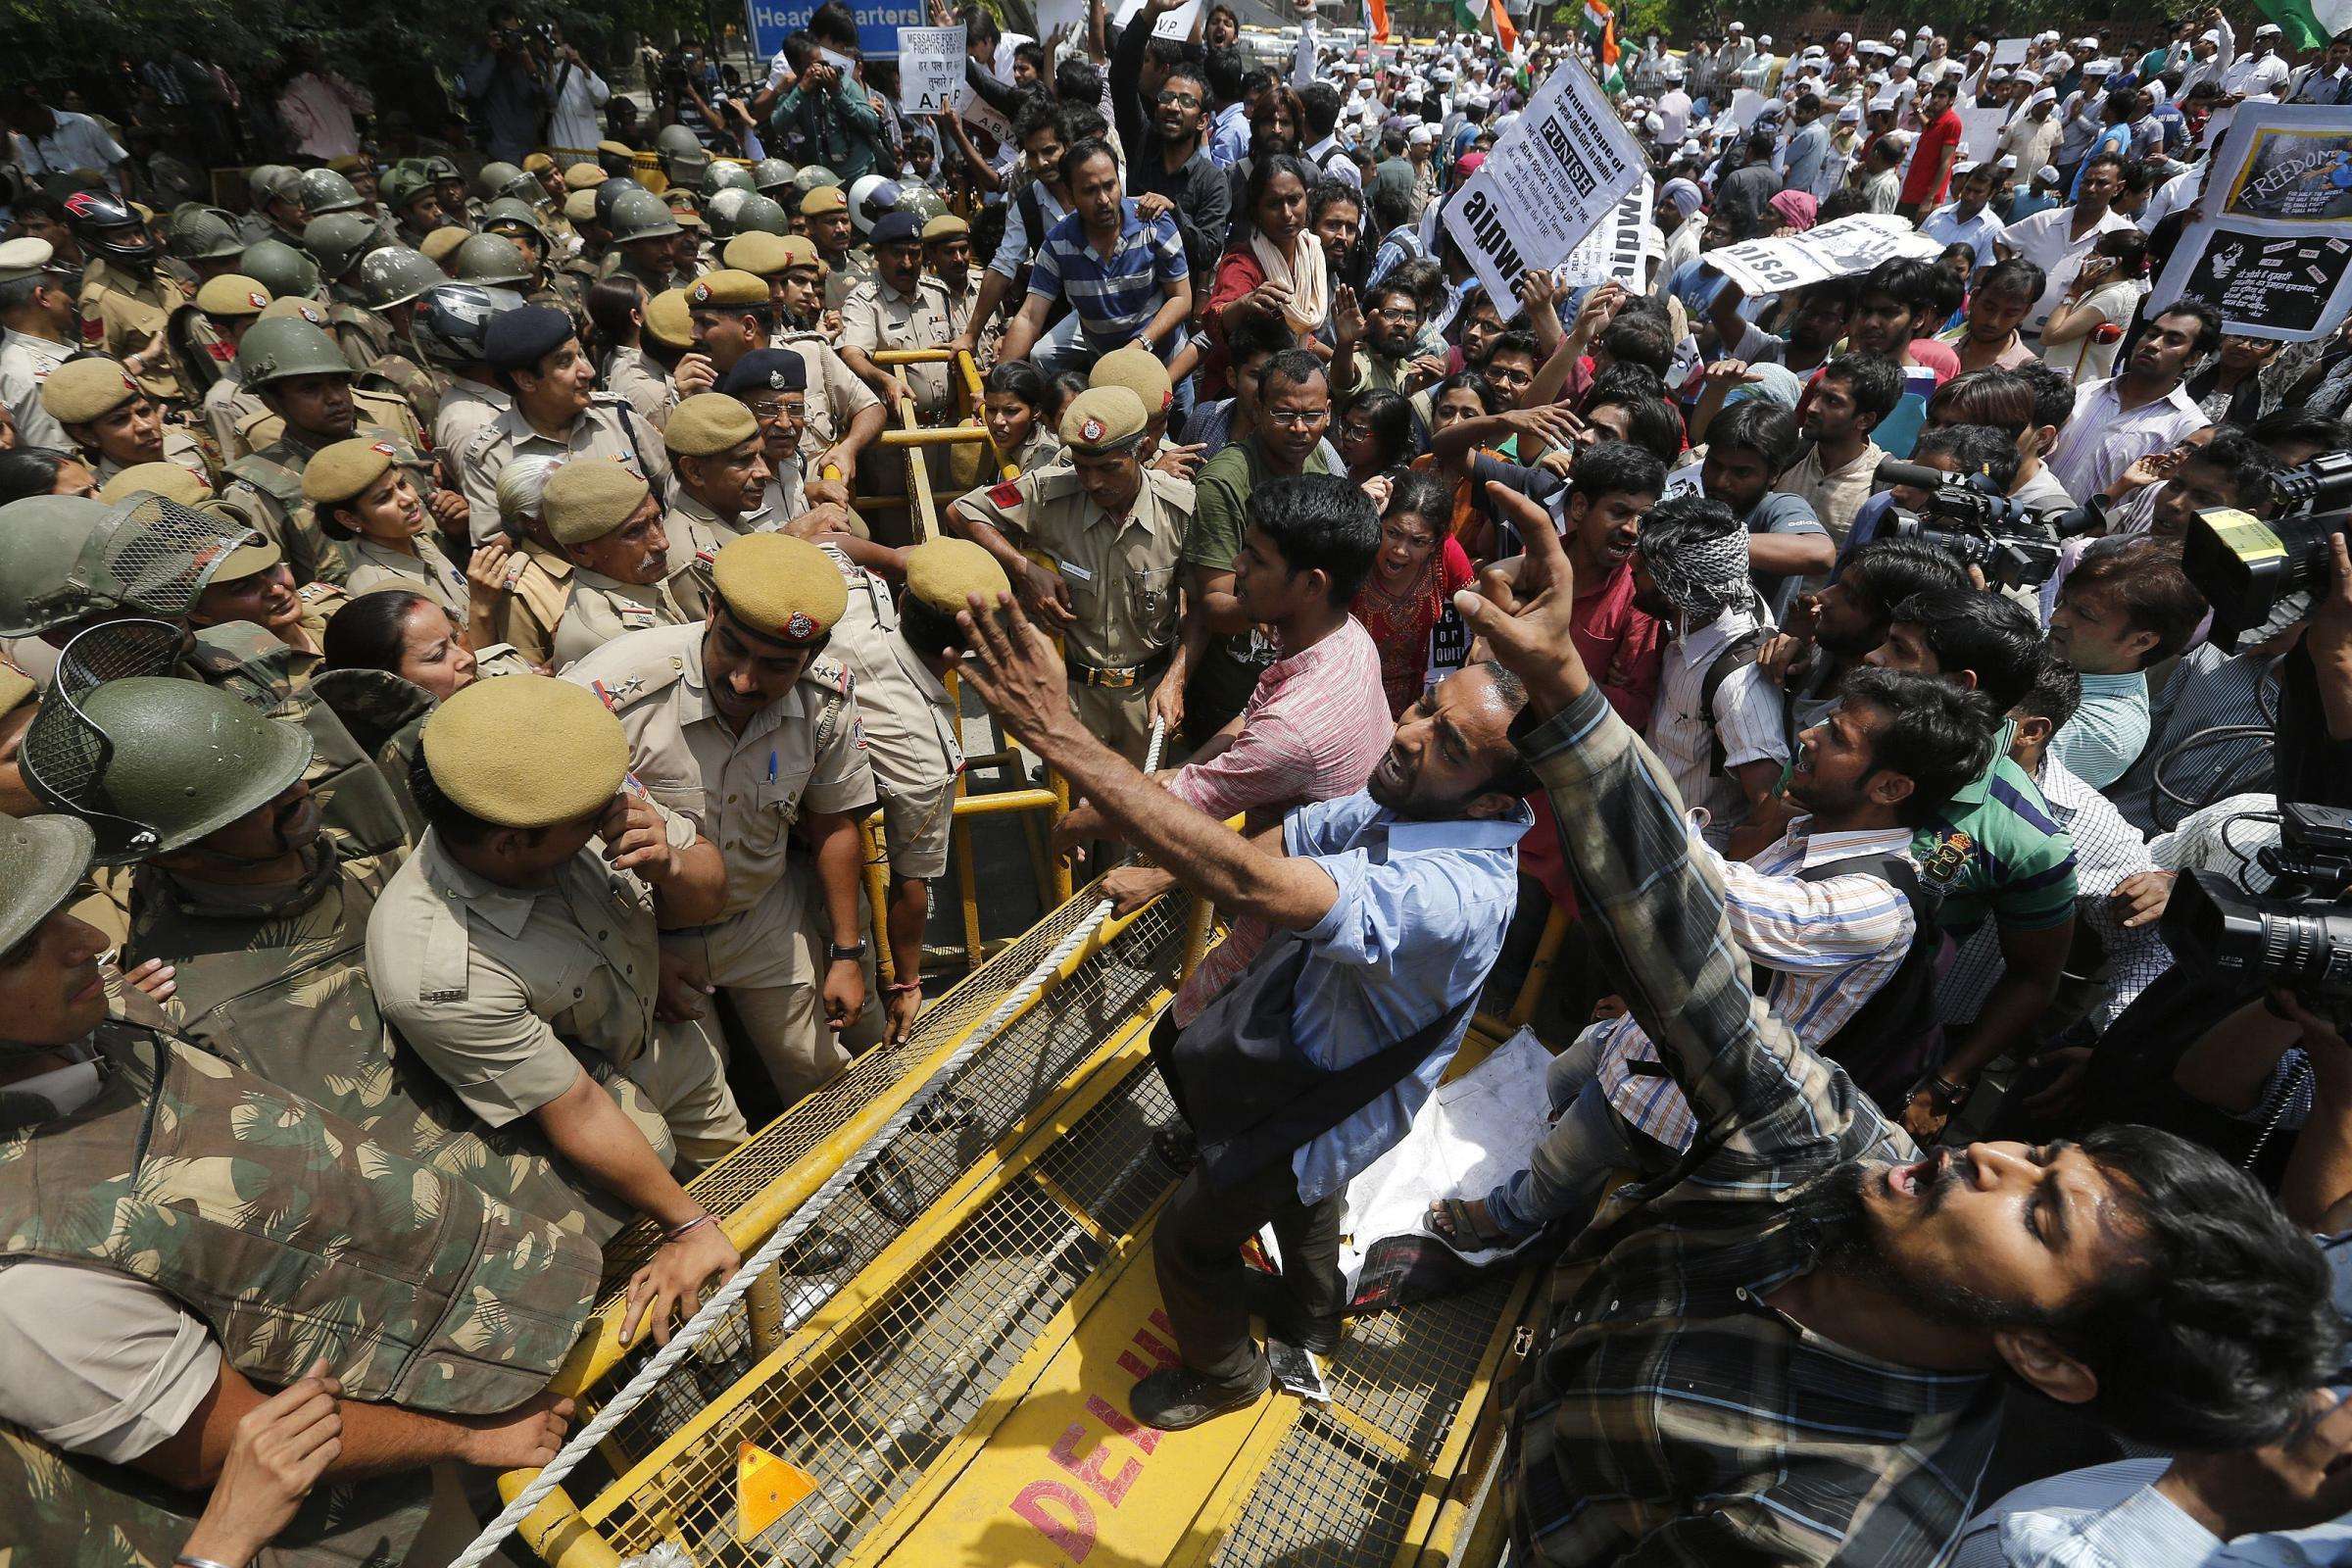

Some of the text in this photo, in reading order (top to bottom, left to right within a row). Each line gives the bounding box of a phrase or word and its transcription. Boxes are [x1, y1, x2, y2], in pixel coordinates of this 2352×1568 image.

[756, 6, 813, 27] Head
[906, 32, 941, 44] MESSAGE
[913, 44, 947, 55] FIGHTING
[979, 118, 1019, 147] A.B.V.
[1553, 94, 1583, 137] 5-year-Old
[1578, 132, 1592, 152] Girl
[1564, 83, 1626, 173] Brutal Rape of
[1519, 140, 1574, 223] DELHI POLICE TO HUSH UP
[1525, 122, 1537, 139] THE
[1532, 136, 1554, 170] CRIMINAL
[1550, 167, 1574, 198] ATTEMPT
[1569, 195, 1581, 209] BY
[1576, 206, 1590, 224] THE
[1542, 120, 1593, 195] PUNISH
[2239, 150, 2333, 209] FREEDOM
[1503, 170, 1516, 184] and
[1511, 180, 1533, 213] Delaying
[1530, 209, 1539, 222] the
[1506, 145, 1515, 160] the
[1512, 156, 1524, 174] Case
[1521, 171, 1530, 184] by
[1542, 205, 1551, 219] the
[1548, 214, 1567, 242] Parents
[1571, 250, 1580, 270] DELHI
[1726, 245, 1798, 284] aisa
